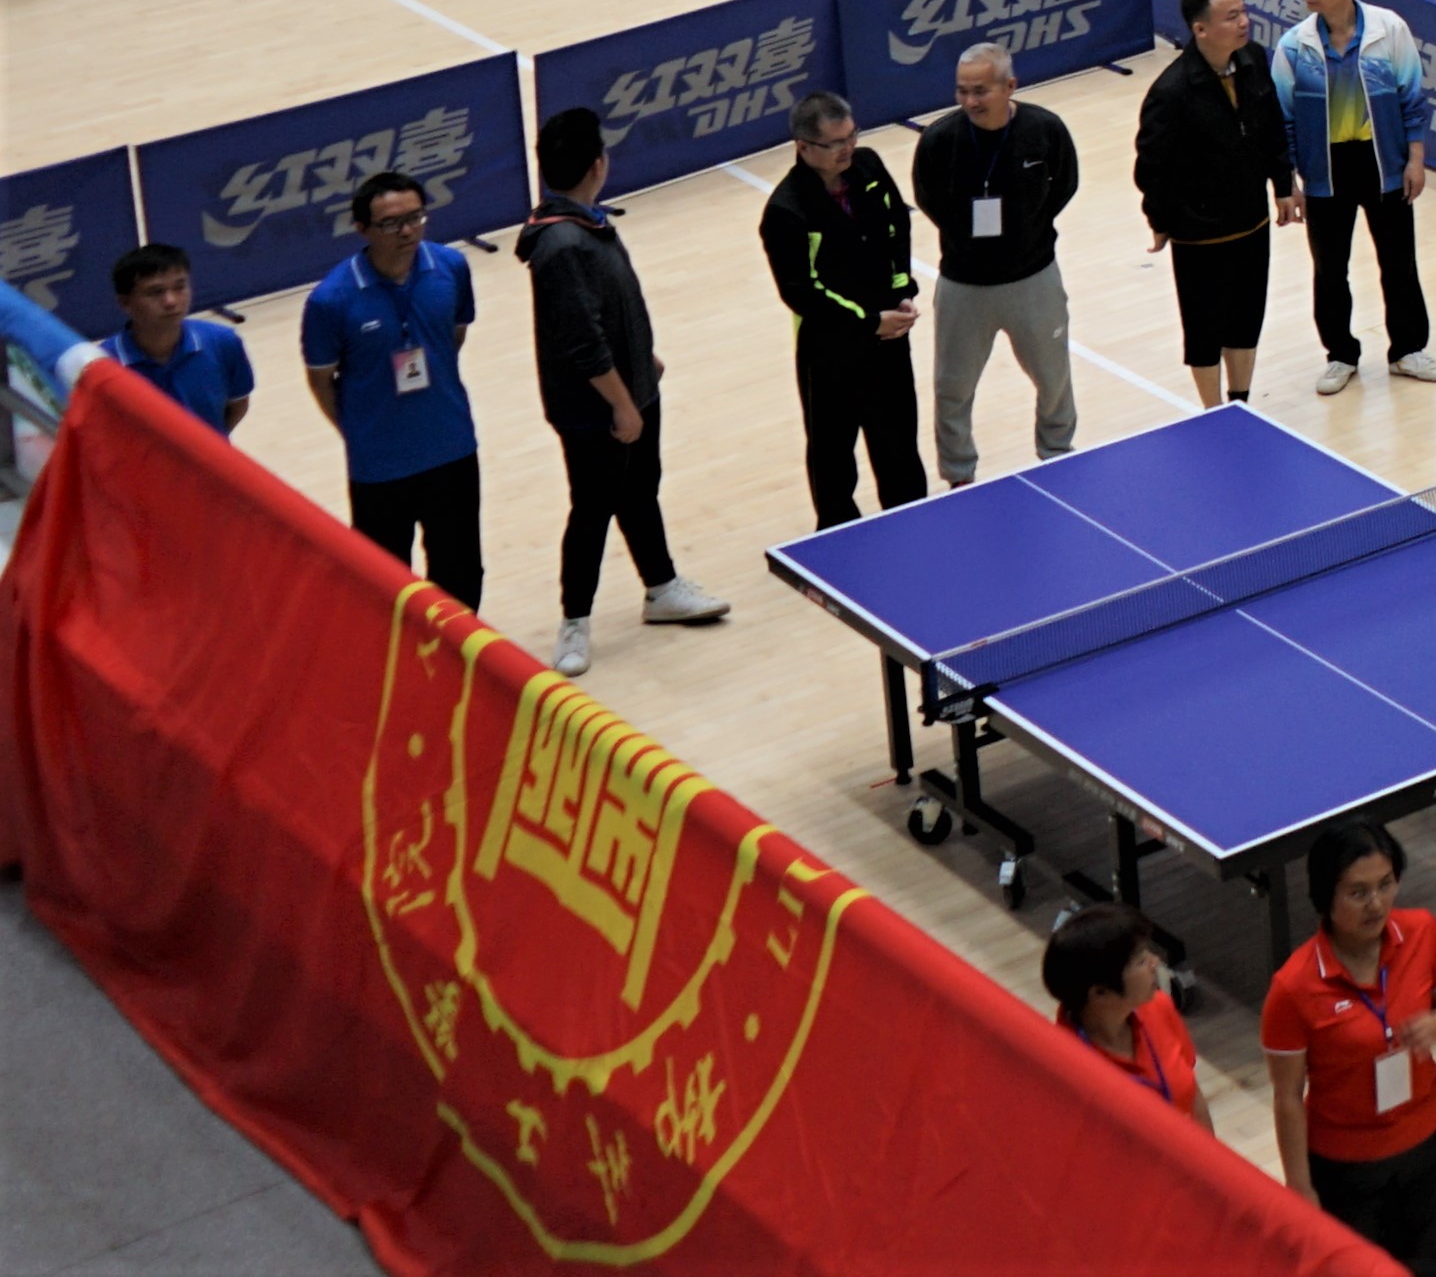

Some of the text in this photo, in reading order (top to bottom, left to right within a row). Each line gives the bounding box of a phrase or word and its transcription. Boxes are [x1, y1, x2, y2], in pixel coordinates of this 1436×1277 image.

[603, 17, 816, 144] 红双喜
[989, 1, 1101, 54] DHS
[203, 107, 473, 242] 红双喜
